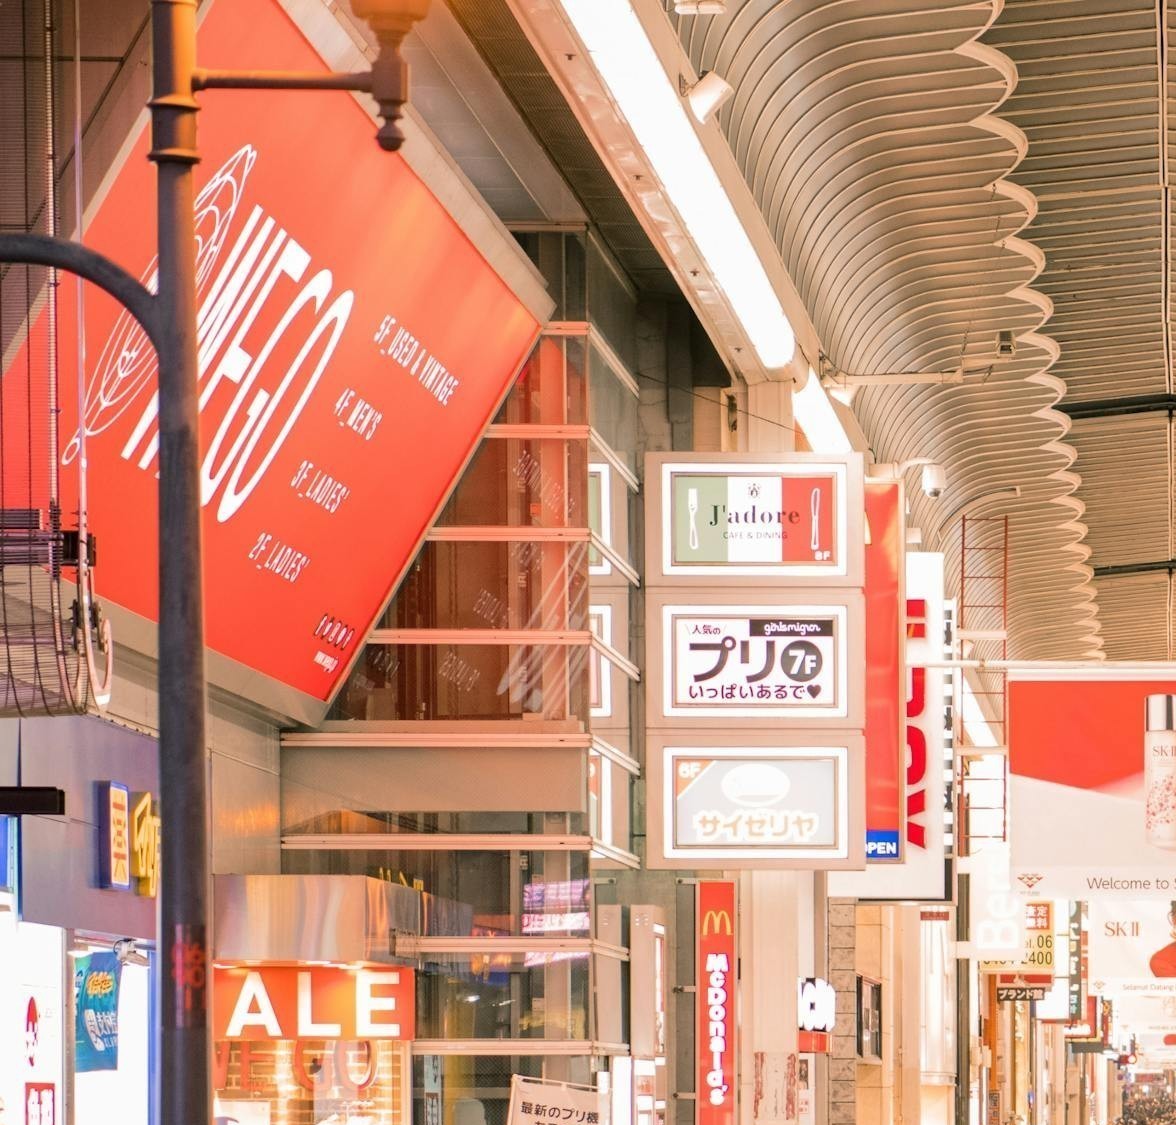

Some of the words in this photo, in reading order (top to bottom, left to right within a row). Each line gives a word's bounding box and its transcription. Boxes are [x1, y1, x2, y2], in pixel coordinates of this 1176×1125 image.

[709, 504, 801, 527] J'adore
[747, 531, 754, 540] &
[756, 531, 789, 540] DINING
[691, 624, 722, 635] 人気の
[689, 636, 776, 684] プリ
[788, 649, 817, 675] 7F
[863, 841, 897, 854] PEN
[1087, 876, 1152, 890] Welcome
[1155, 877, 1170, 890] to
[226, 971, 400, 1037] ALE
[706, 953, 730, 1106] McDonald's
[520, 1100, 600, 1125] 最新のプリ機
